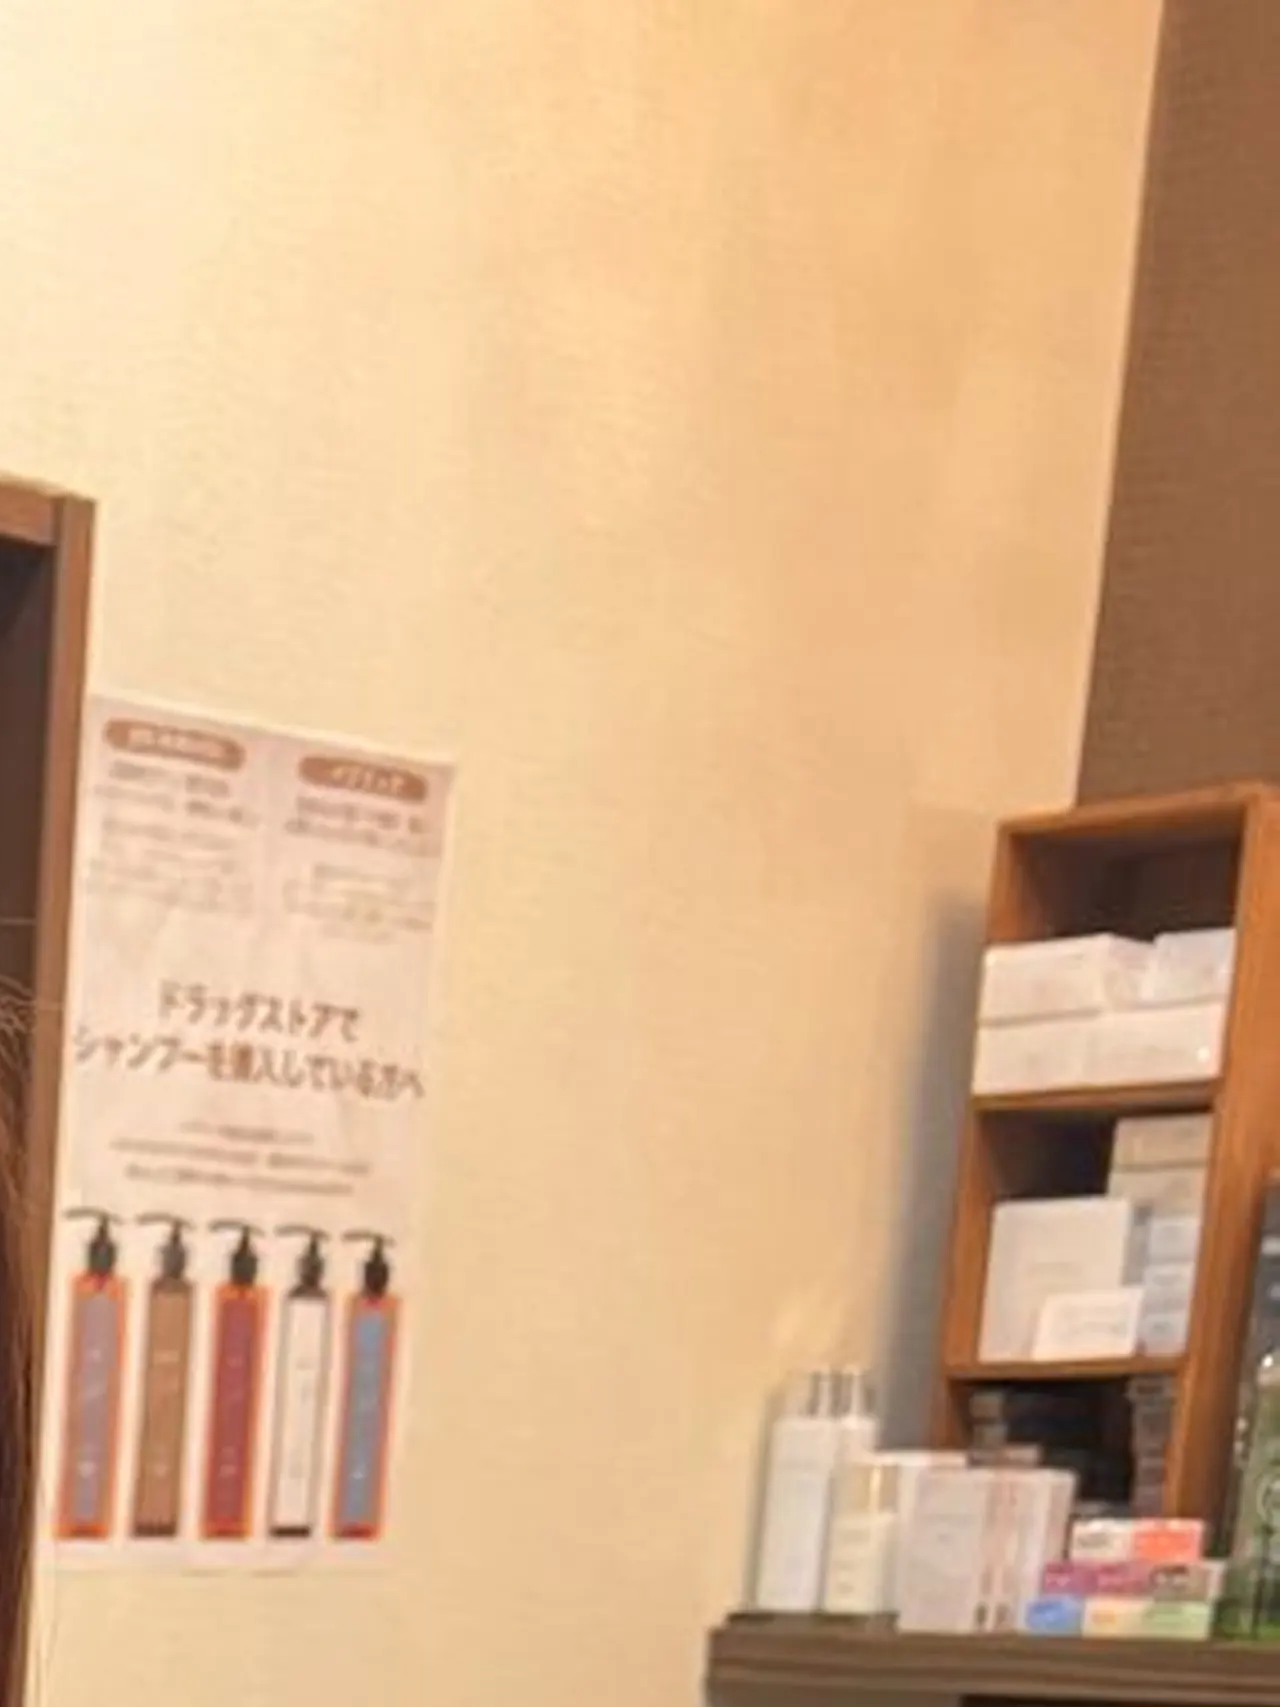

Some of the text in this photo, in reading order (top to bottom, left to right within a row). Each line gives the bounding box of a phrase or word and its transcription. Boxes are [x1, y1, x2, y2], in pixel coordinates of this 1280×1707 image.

[159, 979, 361, 1042] ドラッグストアで
